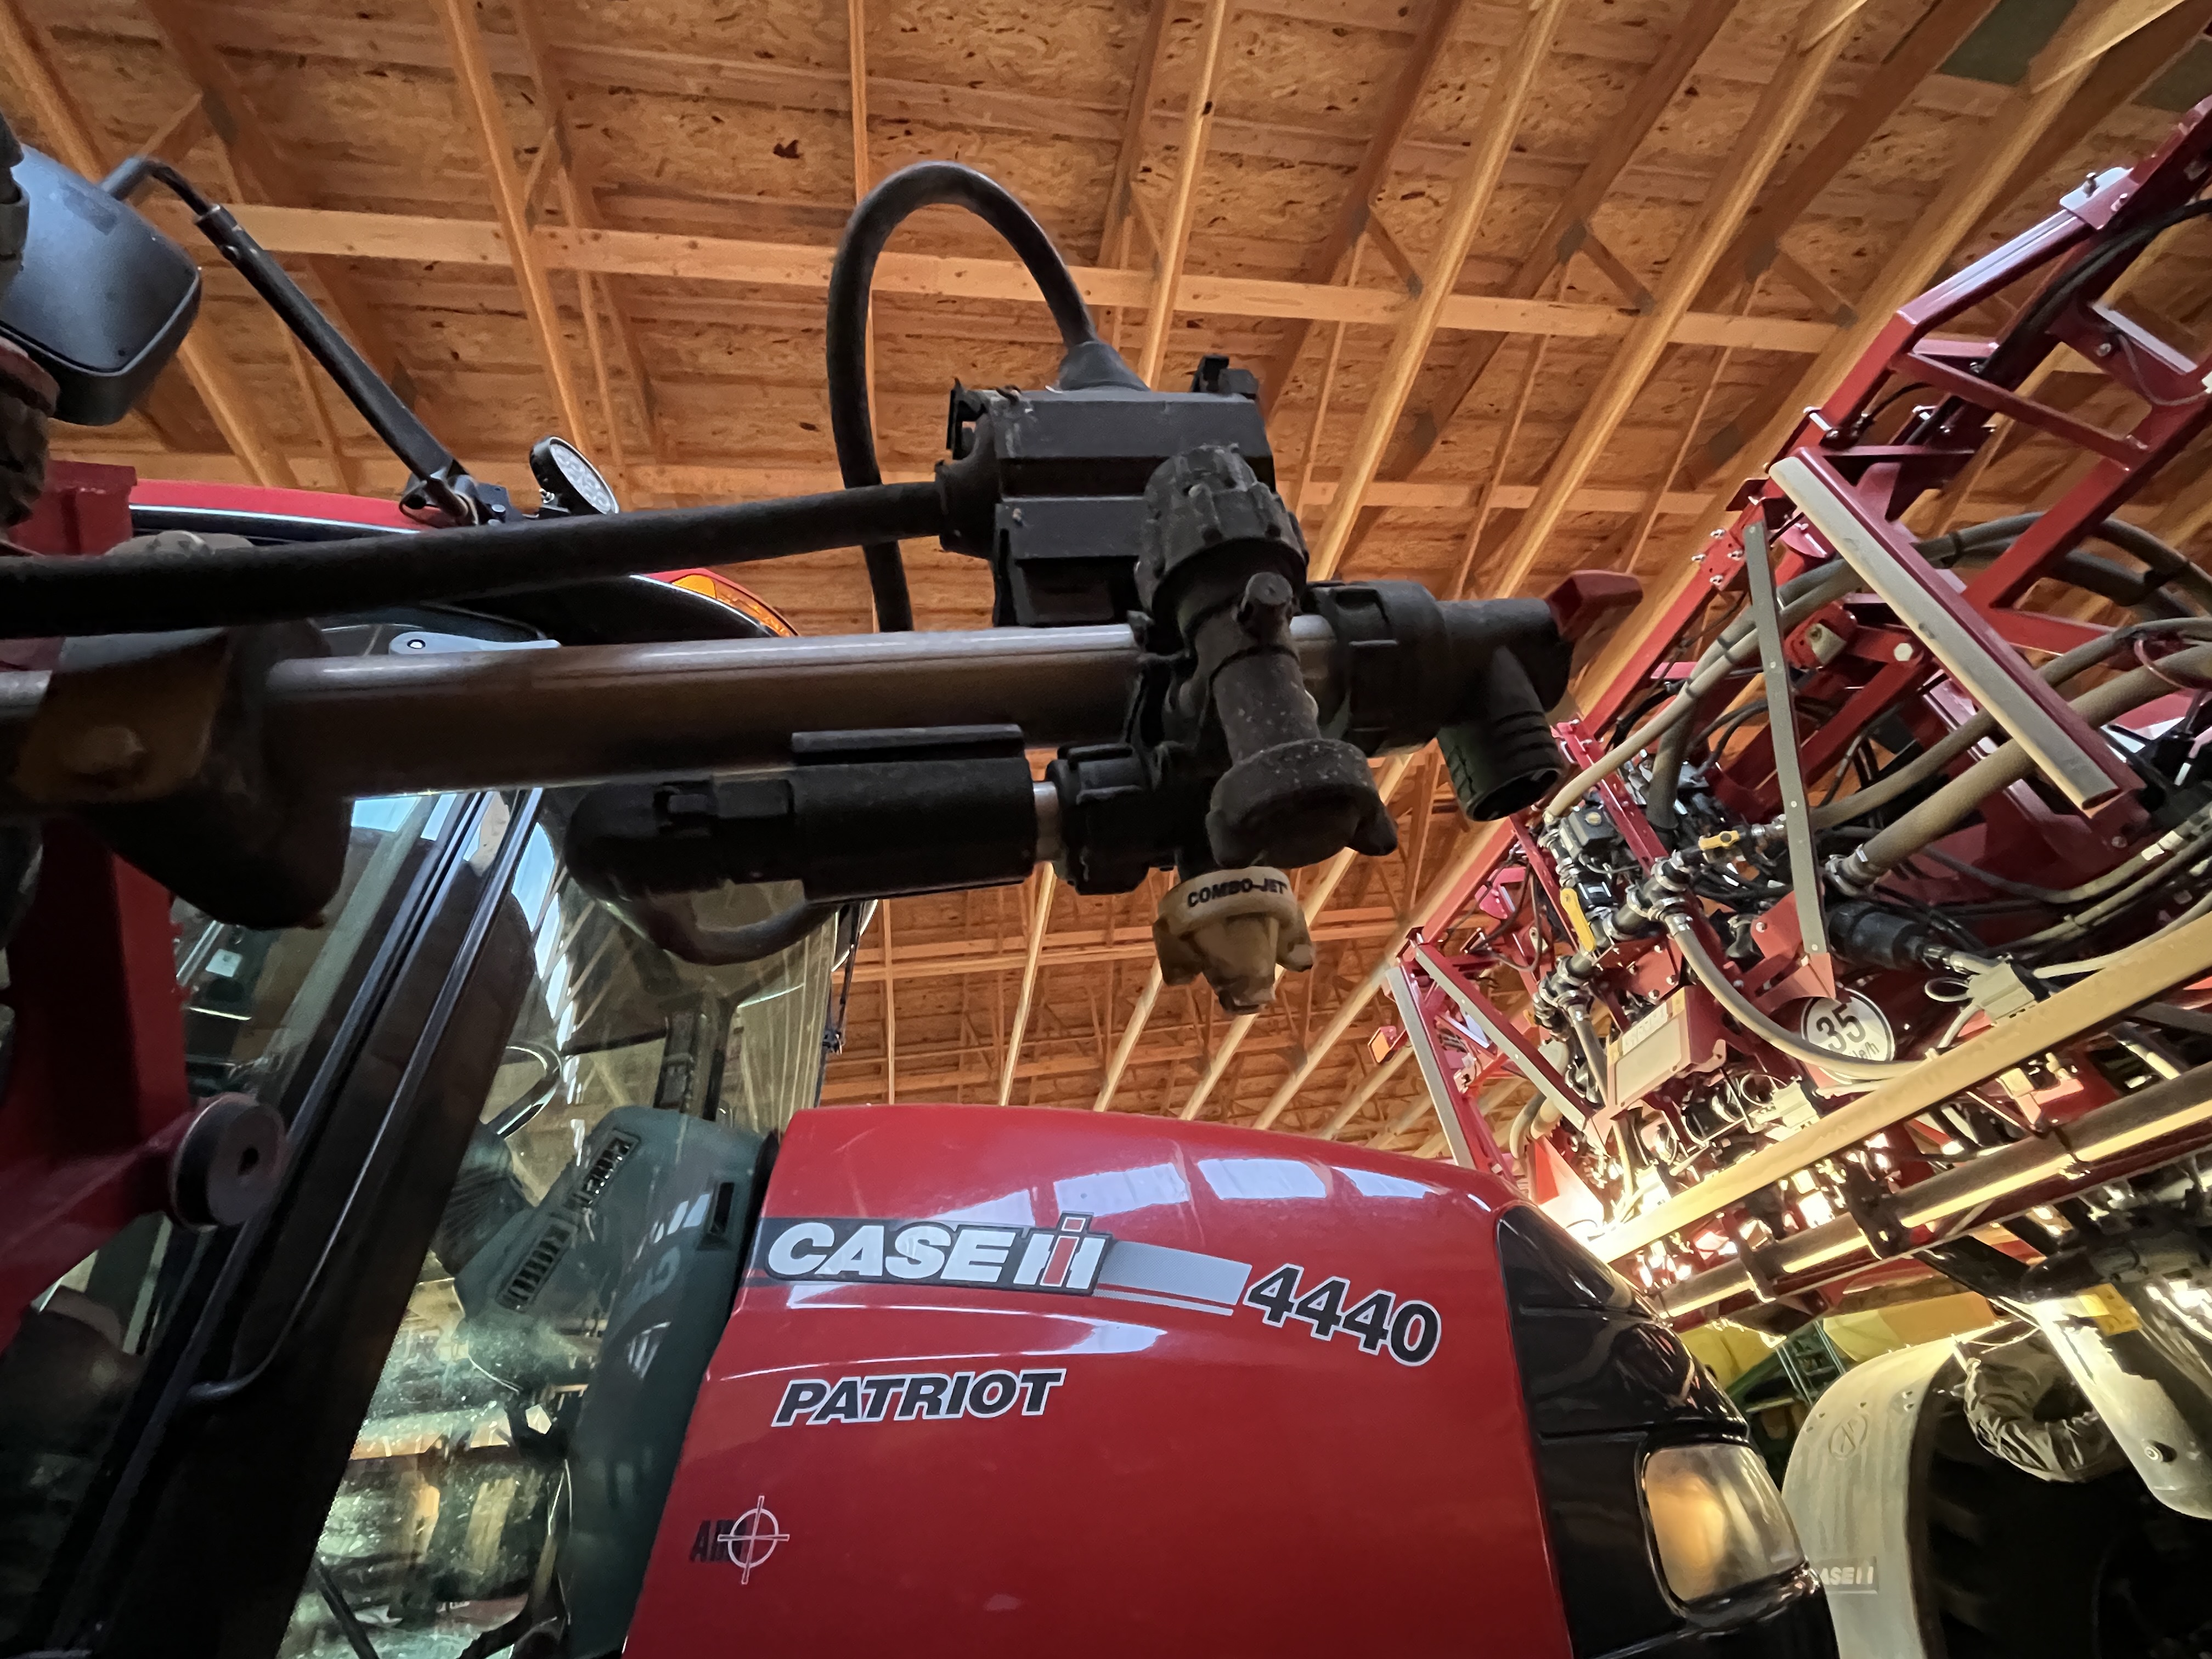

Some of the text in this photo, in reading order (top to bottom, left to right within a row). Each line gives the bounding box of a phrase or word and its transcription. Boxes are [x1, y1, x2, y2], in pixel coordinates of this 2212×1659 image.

[1187, 877, 1288, 908] COMBO-JET
[1816, 1003, 1866, 1054] 35
[768, 1222, 1017, 1283] CASE
[1243, 1263, 1442, 1367] 4440
[771, 1368, 1066, 1427] PATRIOT
[1819, 1566, 1855, 1585] ASE
